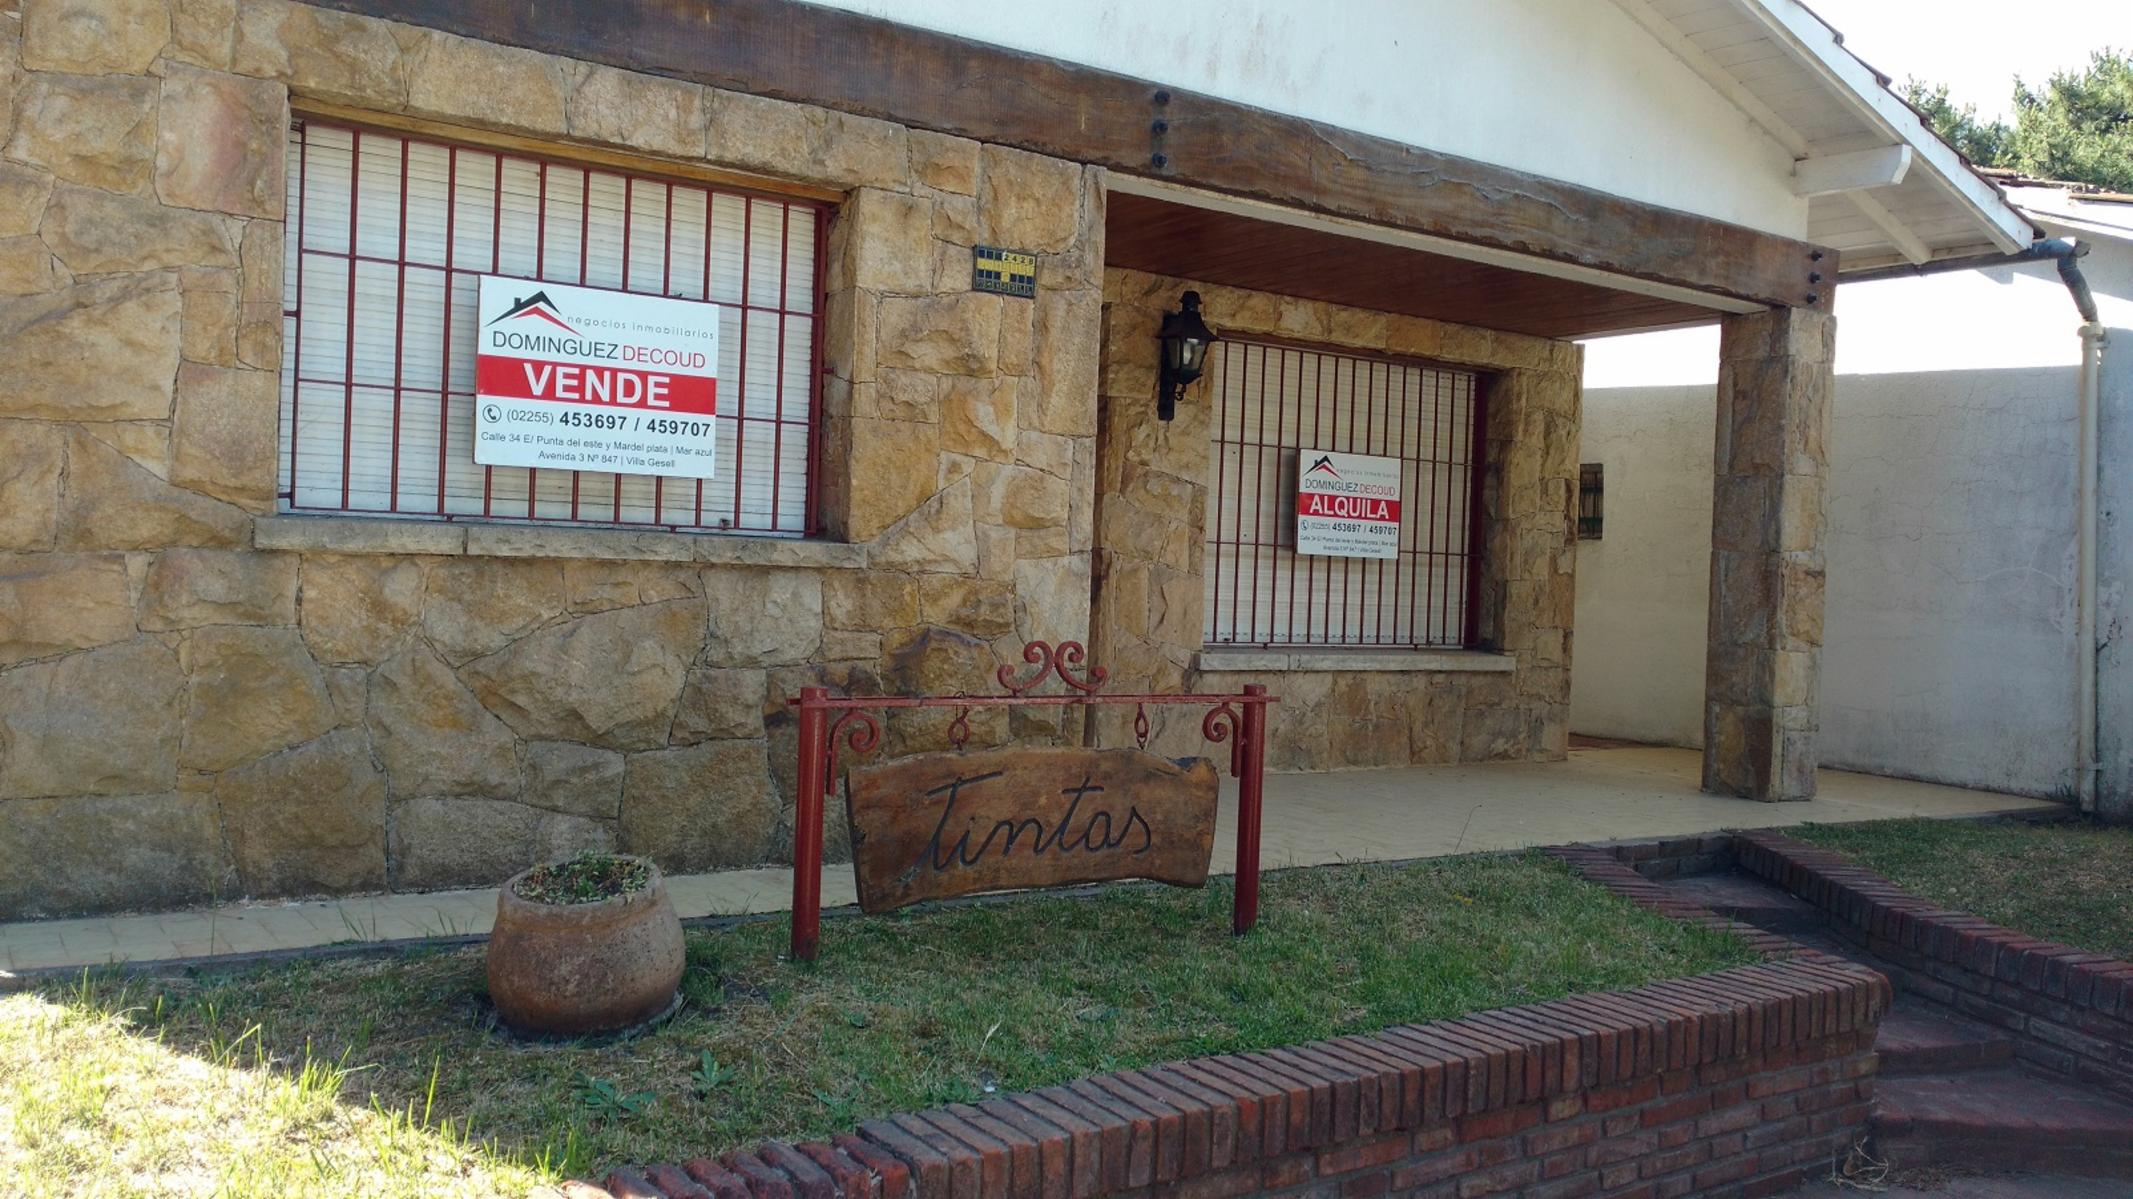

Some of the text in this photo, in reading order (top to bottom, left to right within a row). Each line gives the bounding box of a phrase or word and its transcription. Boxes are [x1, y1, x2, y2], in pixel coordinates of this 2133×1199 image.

[492, 330, 706, 369] DOMINGUEZ DECOUD
[523, 362, 670, 408] VENDE
[507, 409, 711, 438] (02255) 453697 / 459707
[480, 431, 506, 442] Calle
[508, 433, 520, 442] 34
[523, 434, 534, 444] E/
[536, 435, 564, 446] Punta
[566, 438, 581, 448] del
[583, 440, 603, 449] este
[605, 442, 612, 451] y
[646, 444, 669, 454] plata
[538, 450, 576, 461] Avenida
[578, 453, 585, 461] 3
[601, 455, 618, 464] 847
[626, 456, 645, 466] Villa
[647, 458, 675, 468] Gesell
[1305, 479, 1396, 497] DOMINGUEZ DECOUD
[1309, 494, 1390, 520] ALQUILA
[912, 770, 1152, 875] Tintas
